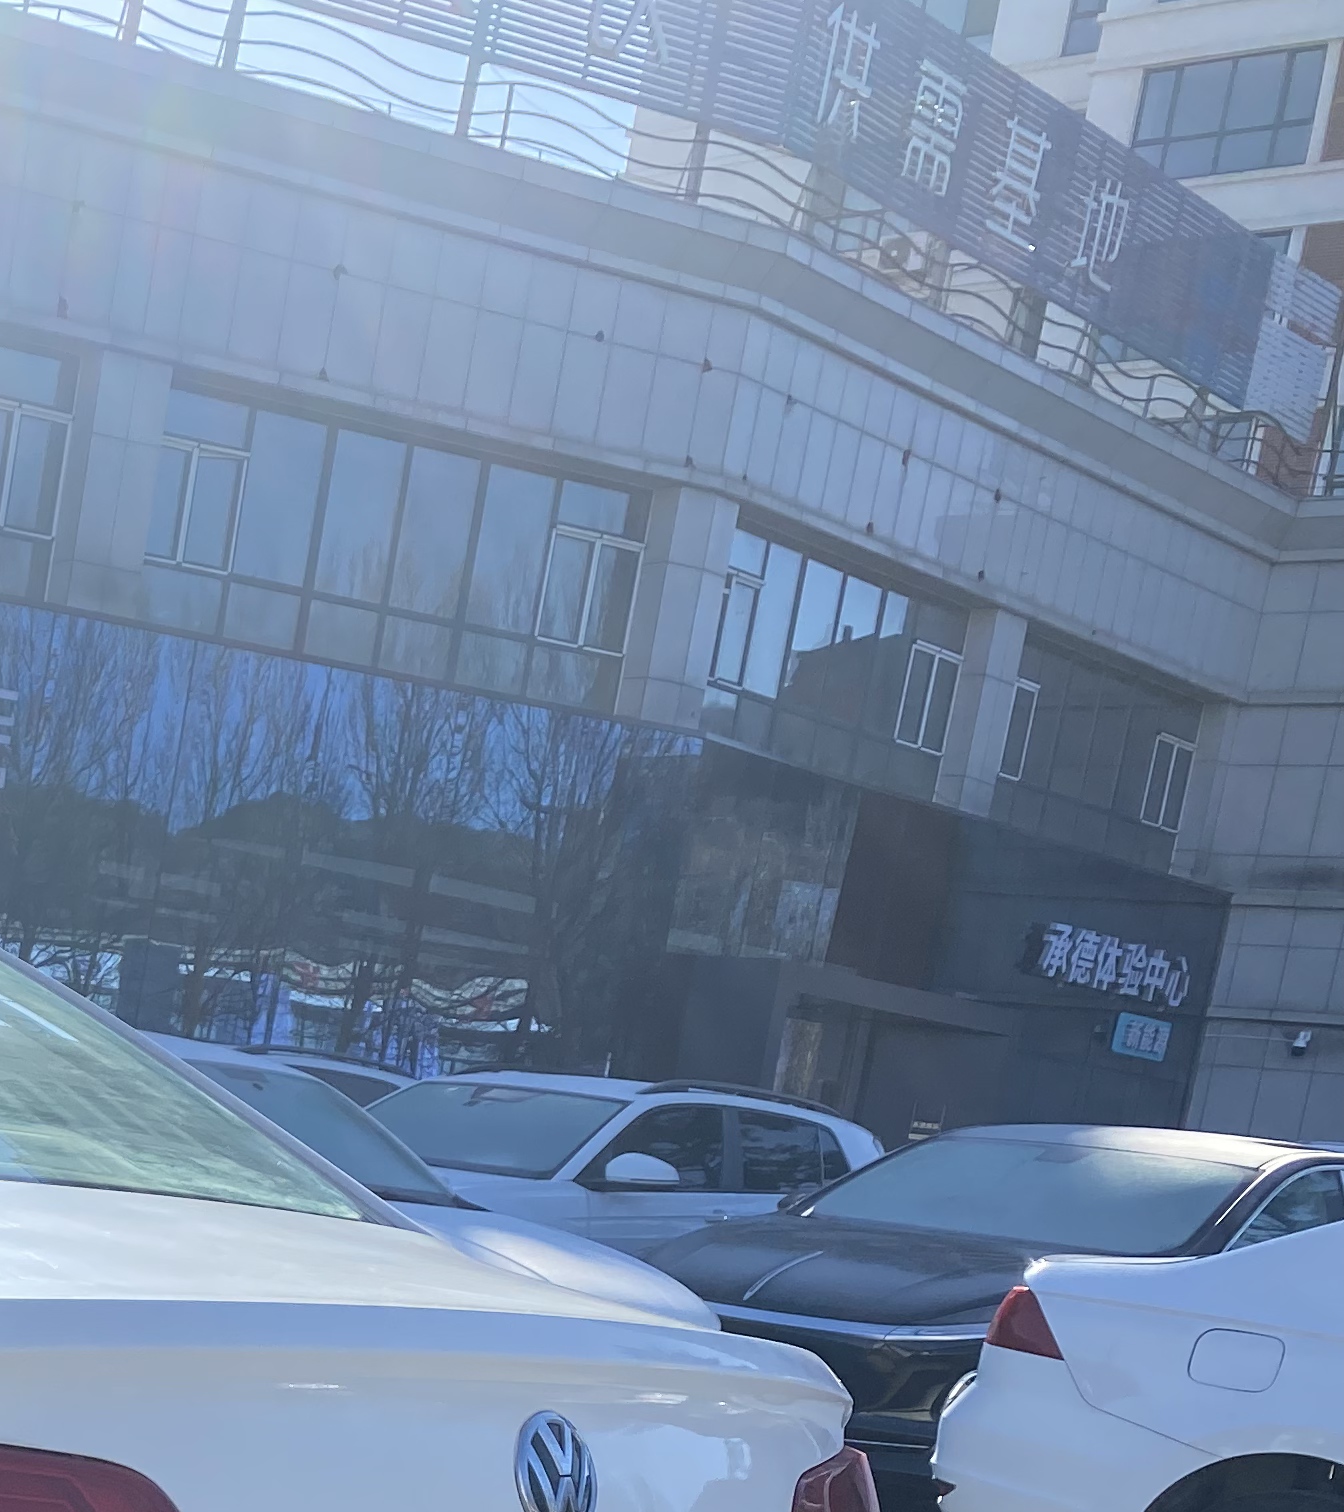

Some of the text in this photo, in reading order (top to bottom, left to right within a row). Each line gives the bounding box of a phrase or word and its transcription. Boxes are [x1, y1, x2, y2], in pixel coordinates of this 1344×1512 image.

[1042, 921, 1190, 1007] 承德体验中心
